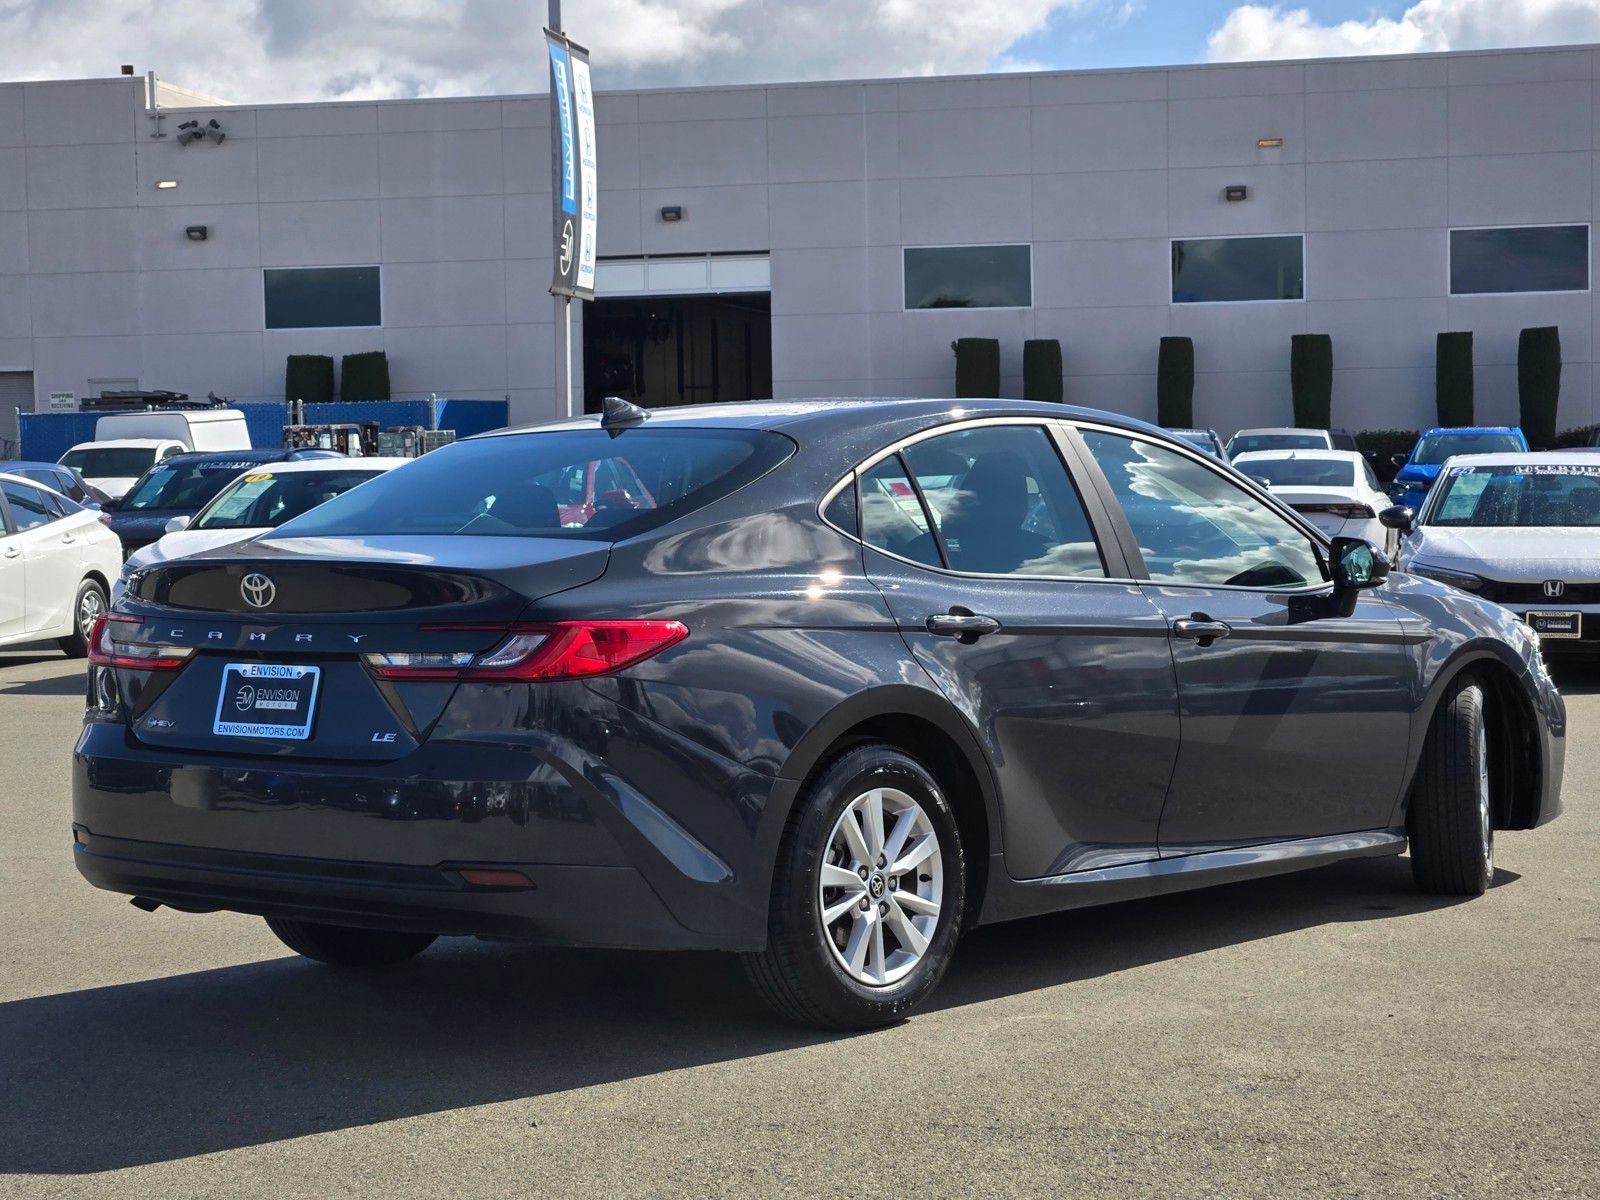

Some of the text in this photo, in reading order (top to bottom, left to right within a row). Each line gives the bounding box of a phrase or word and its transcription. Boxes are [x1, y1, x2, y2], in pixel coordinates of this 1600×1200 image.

[554, 58, 574, 201] ENVISION
[170, 629, 368, 643] CAMRY
[251, 666, 293, 677] ENVISION
[256, 688, 300, 701] ENVISION
[217, 724, 305, 737] ENVISIONMOTORS.COM
[371, 732, 397, 742] LE
